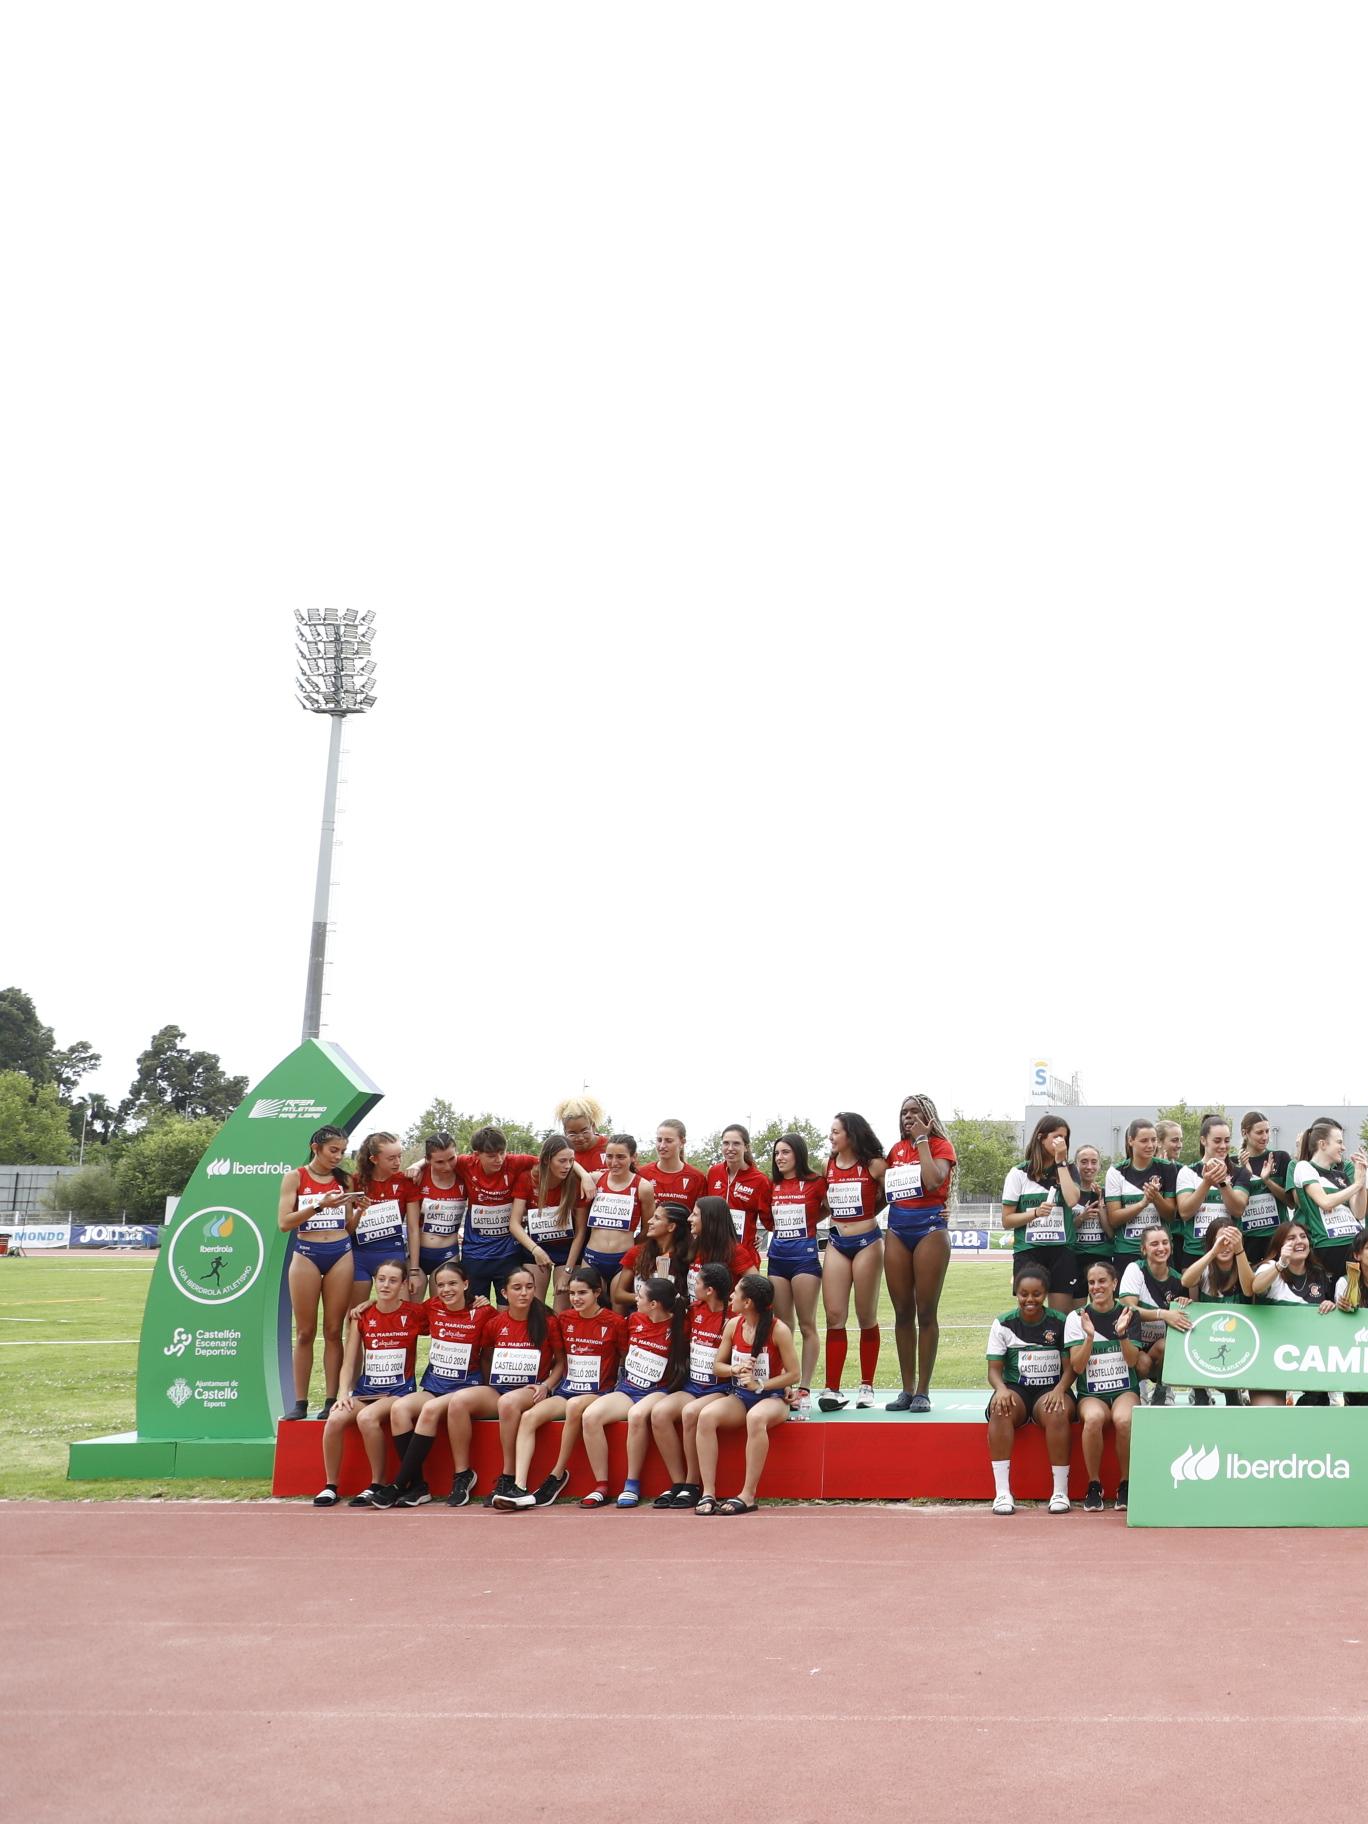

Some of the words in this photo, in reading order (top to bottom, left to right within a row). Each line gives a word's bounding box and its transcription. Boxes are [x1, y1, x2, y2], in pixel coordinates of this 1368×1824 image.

[232, 1162, 291, 1175] Iberdrola
[887, 1179, 907, 1188] CASTELLÓ
[908, 1175, 919, 1184] 2024
[849, 1194, 860, 1203] 2024
[593, 1204, 618, 1215] CASTELLÓ
[618, 1208, 630, 1216] 2024
[1266, 1206, 1276, 1214] 2024
[386, 1214, 398, 1223] 2024
[427, 1212, 453, 1220] CASTELLÓ
[473, 1216, 499, 1225] CASTELLÓ
[793, 1217, 803, 1225] 2024
[1053, 1220, 1062, 1228] 2024
[15, 1232, 64, 1241] MONDO
[178, 1266, 188, 1281] LIGA
[186, 1278, 221, 1295] IBERDROLA
[222, 1265, 252, 1294] ATLETISMO
[196, 1329, 240, 1338] Castellón
[196, 1339, 237, 1347] Escenario
[195, 1347, 236, 1356] Deportivo
[431, 1352, 453, 1363] CASTELLÓ
[454, 1357, 466, 1366] 2024
[391, 1363, 402, 1371] 2024
[495, 1360, 522, 1370] CASTELLÓ
[524, 1363, 536, 1372] 2024
[627, 1358, 648, 1374] CASTELLÓ
[648, 1368, 661, 1378] 2024
[1021, 1363, 1047, 1373] CASTELLÓ
[1048, 1364, 1059, 1372] 2024
[585, 1369, 597, 1378] 2024
[1089, 1367, 1114, 1378] CASTELLÓ
[1116, 1367, 1127, 1375] 2024
[195, 1388, 238, 1399] Castelló
[1226, 1453, 1350, 1479] Iberdrola
